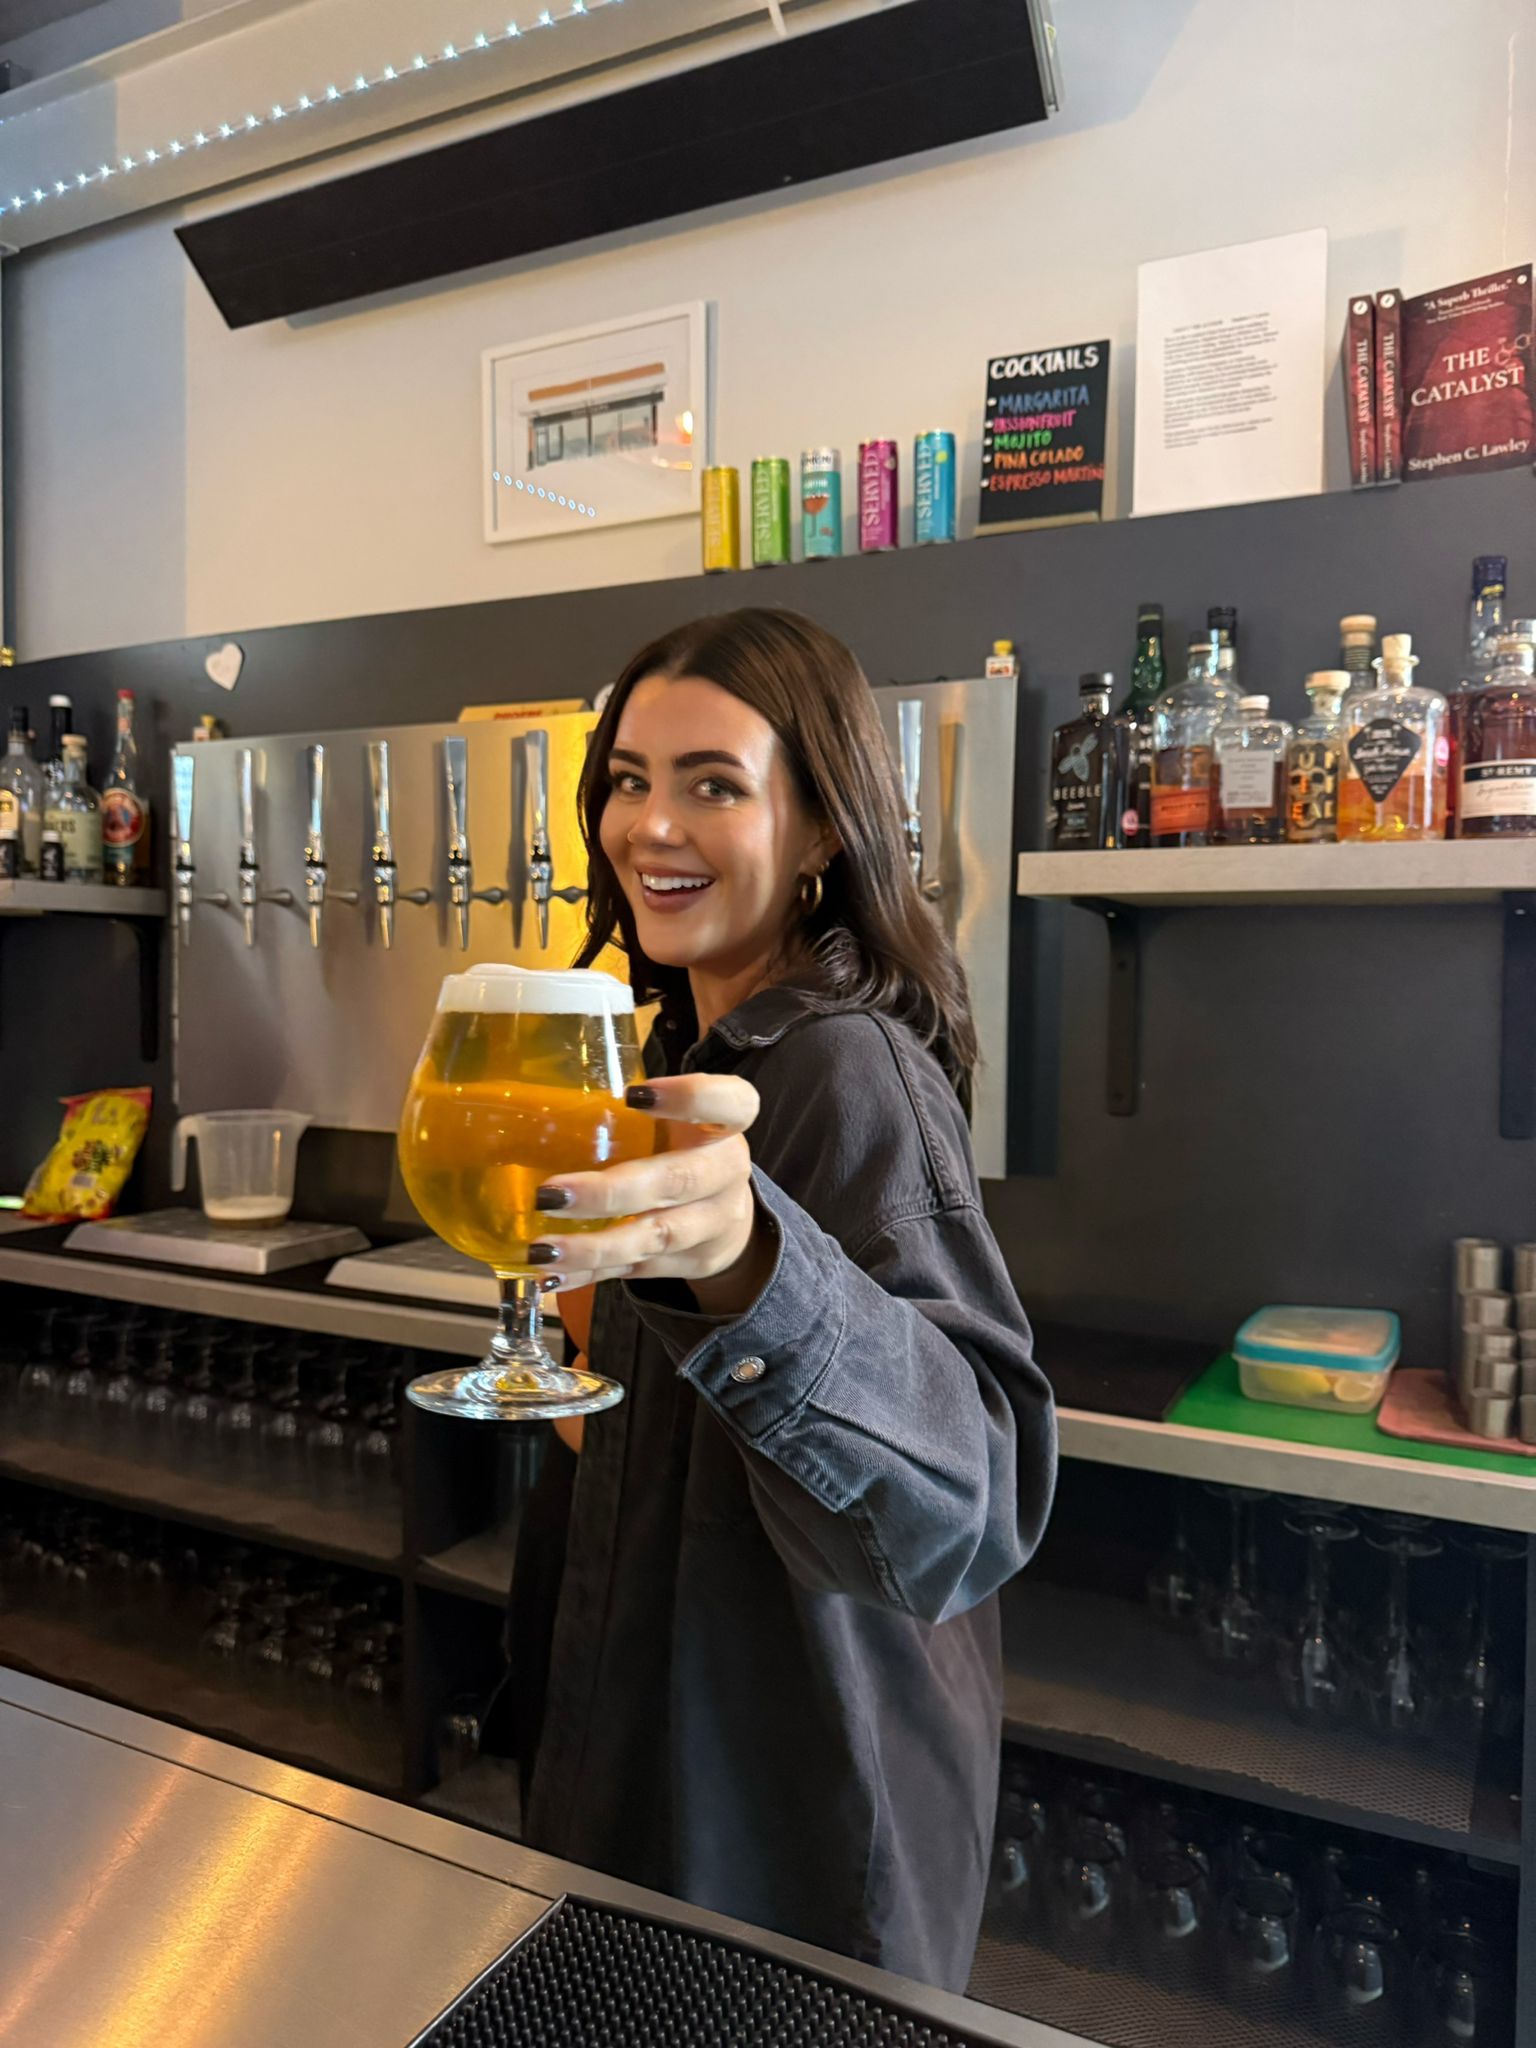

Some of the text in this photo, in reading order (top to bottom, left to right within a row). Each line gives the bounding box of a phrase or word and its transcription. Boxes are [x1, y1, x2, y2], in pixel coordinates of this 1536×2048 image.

[1437, 290, 1471, 308] Superb
[1357, 338, 1368, 365] THE
[1383, 332, 1394, 360] THE
[1442, 346, 1491, 373] THE
[990, 345, 1099, 380] COCKTAILS
[998, 384, 1090, 415] MARGARITA
[1357, 366, 1369, 424] CATALYST
[1382, 361, 1395, 419] CATALYST
[1411, 365, 1525, 406] CATALYST
[993, 409, 1077, 433] PASSIONFRUIT
[994, 430, 1053, 450] MOJITO
[1408, 438, 1531, 471] Stephen C. Lawley
[994, 451, 1028, 469] PINA
[863, 452, 880, 527] SERVED
[917, 442, 932, 519] SERVED
[990, 470, 1050, 492] ESPRESSO
[756, 470, 771, 542] SERVED
[1053, 783, 1102, 800] BEEBLE
